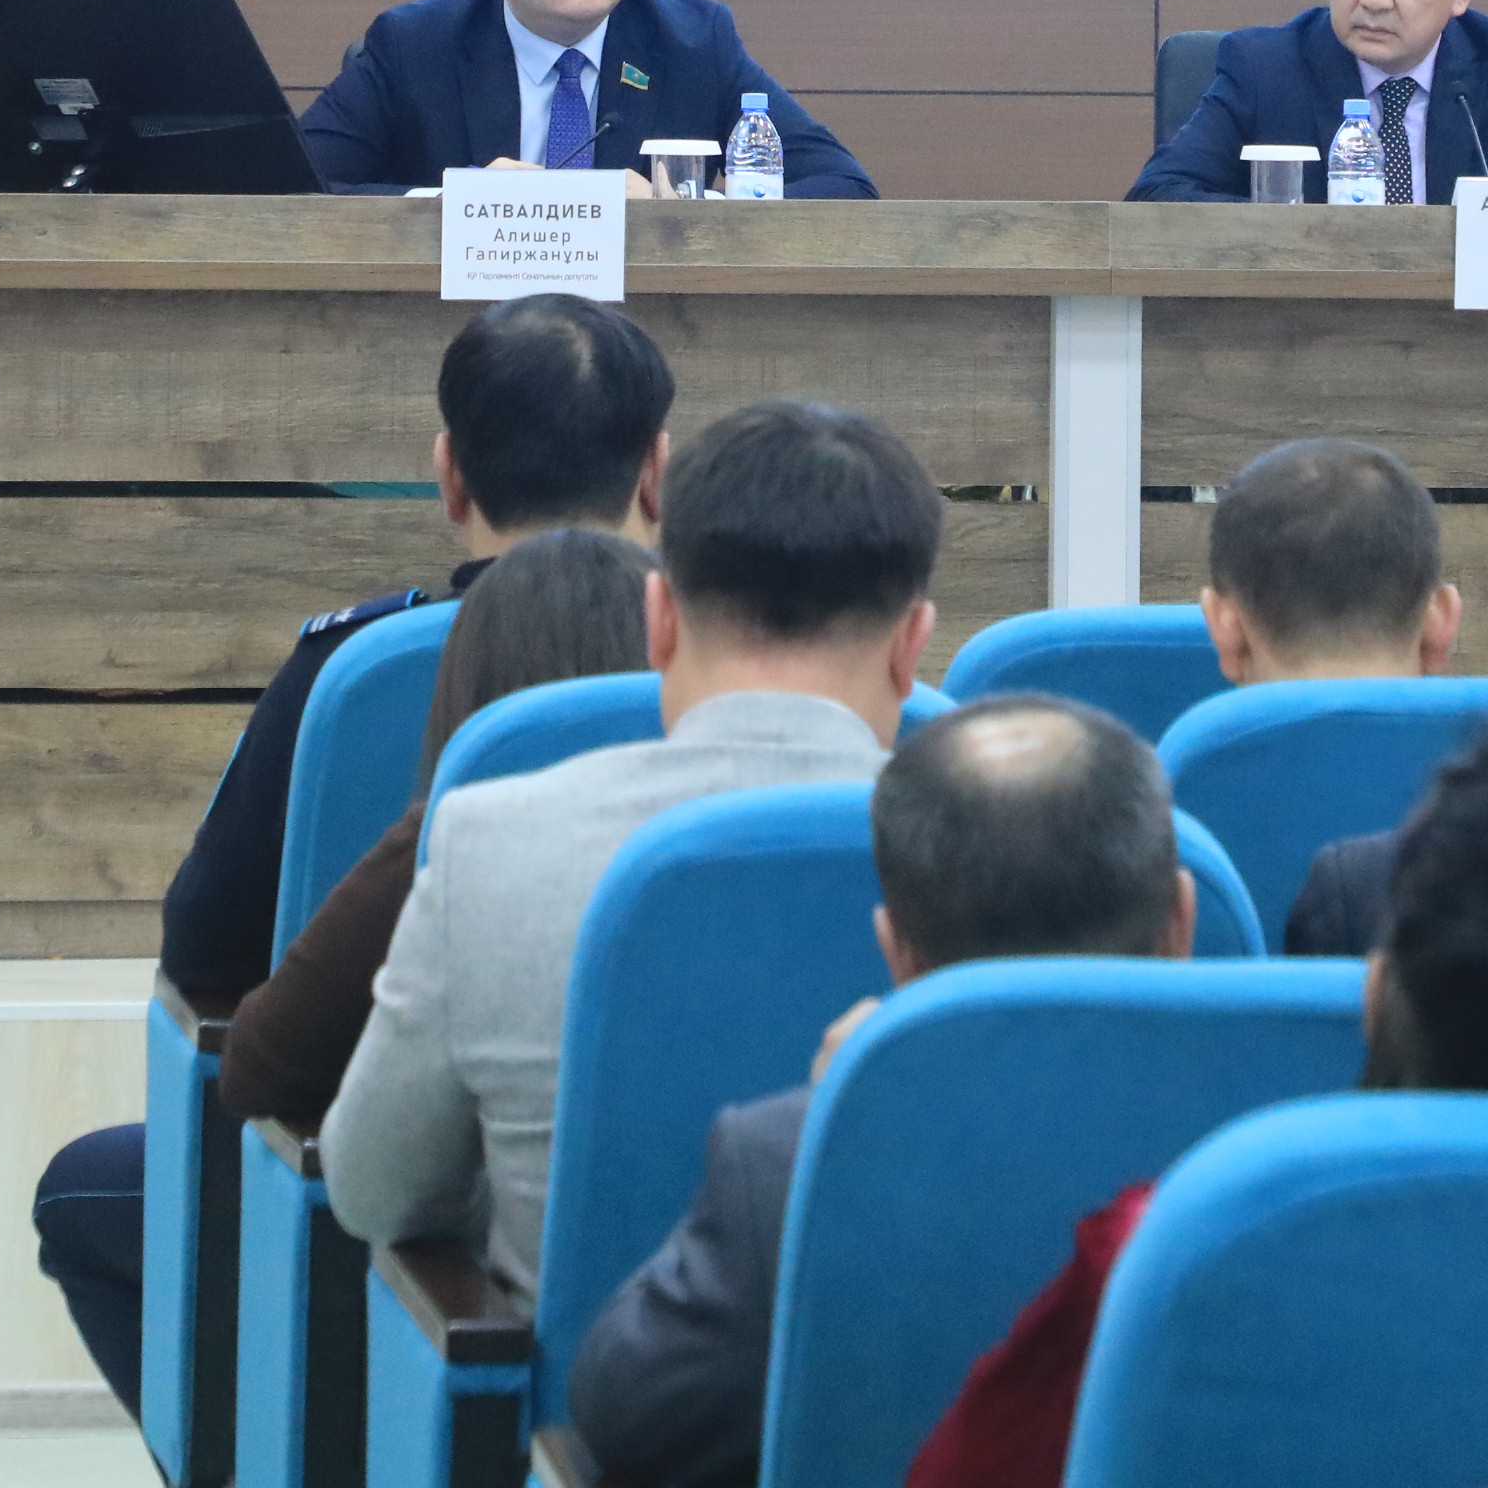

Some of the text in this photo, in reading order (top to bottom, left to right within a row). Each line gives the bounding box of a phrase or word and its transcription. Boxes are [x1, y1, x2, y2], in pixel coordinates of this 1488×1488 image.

[464, 203, 602, 222] САТВАЛДИЕВ
[493, 227, 572, 246] Алишер
[465, 246, 599, 265] Гапиржанұлы
